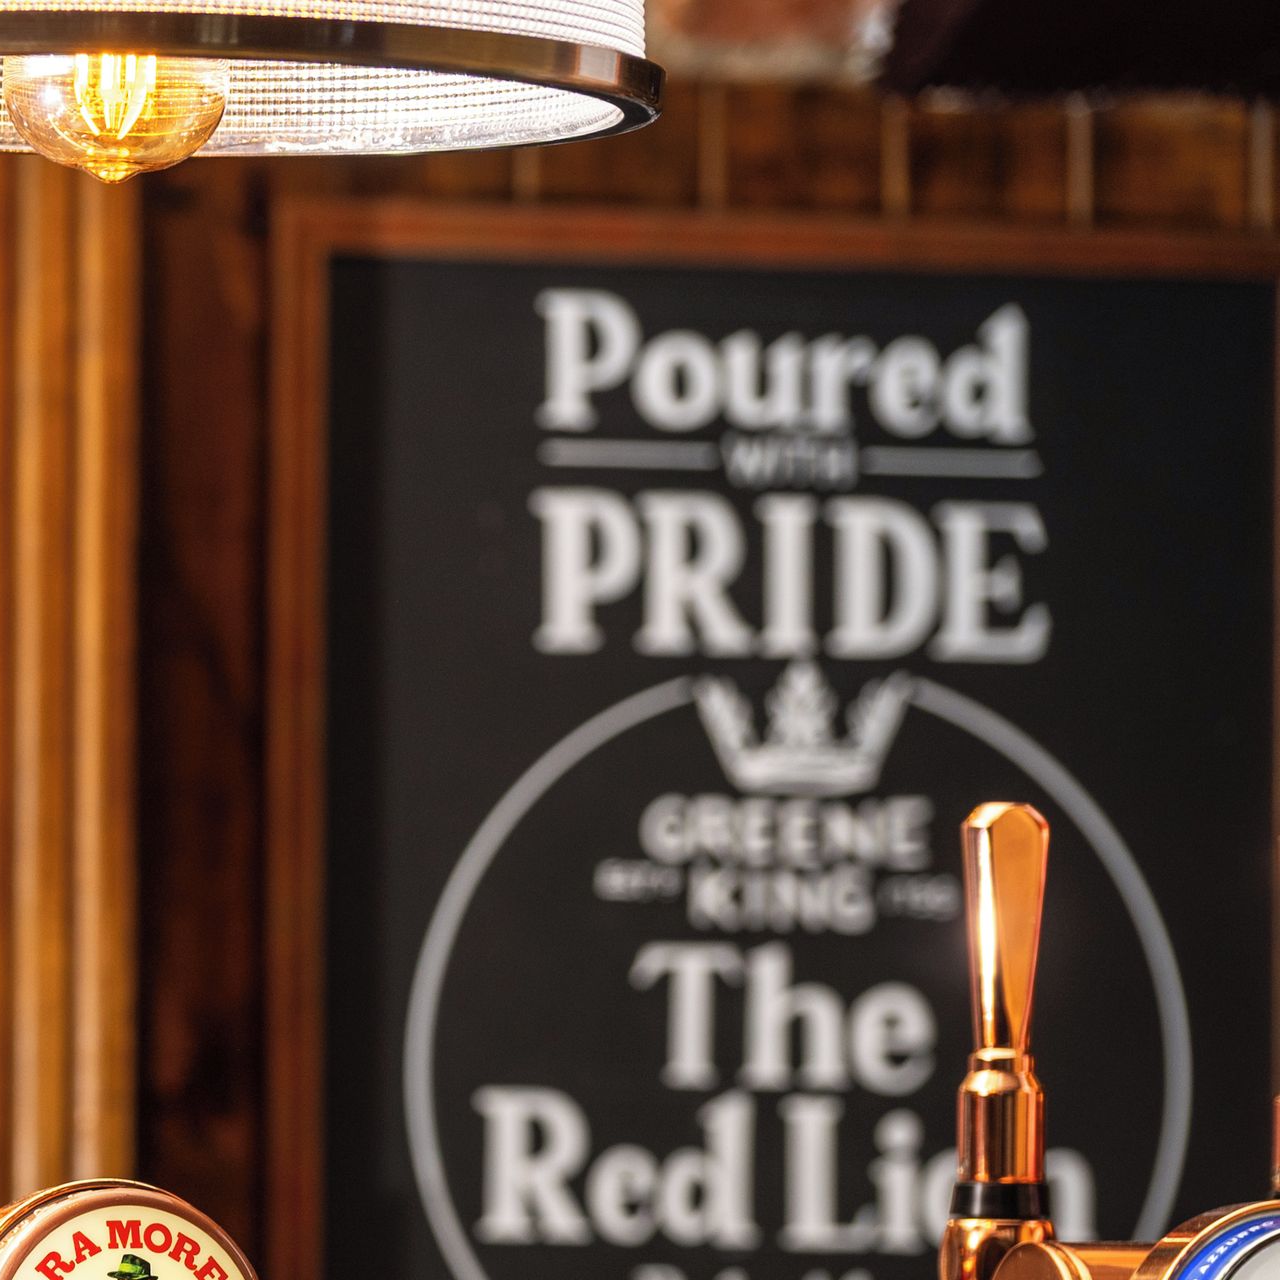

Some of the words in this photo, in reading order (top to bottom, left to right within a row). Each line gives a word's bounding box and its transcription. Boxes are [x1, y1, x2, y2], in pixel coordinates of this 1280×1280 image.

[533, 288, 1034, 444] Poured
[527, 487, 1052, 664] PRIDE
[639, 794, 932, 870] GREENE
[686, 860, 875, 934] KING
[630, 940, 936, 1096] The
[472, 1085, 758, 1248] Red
